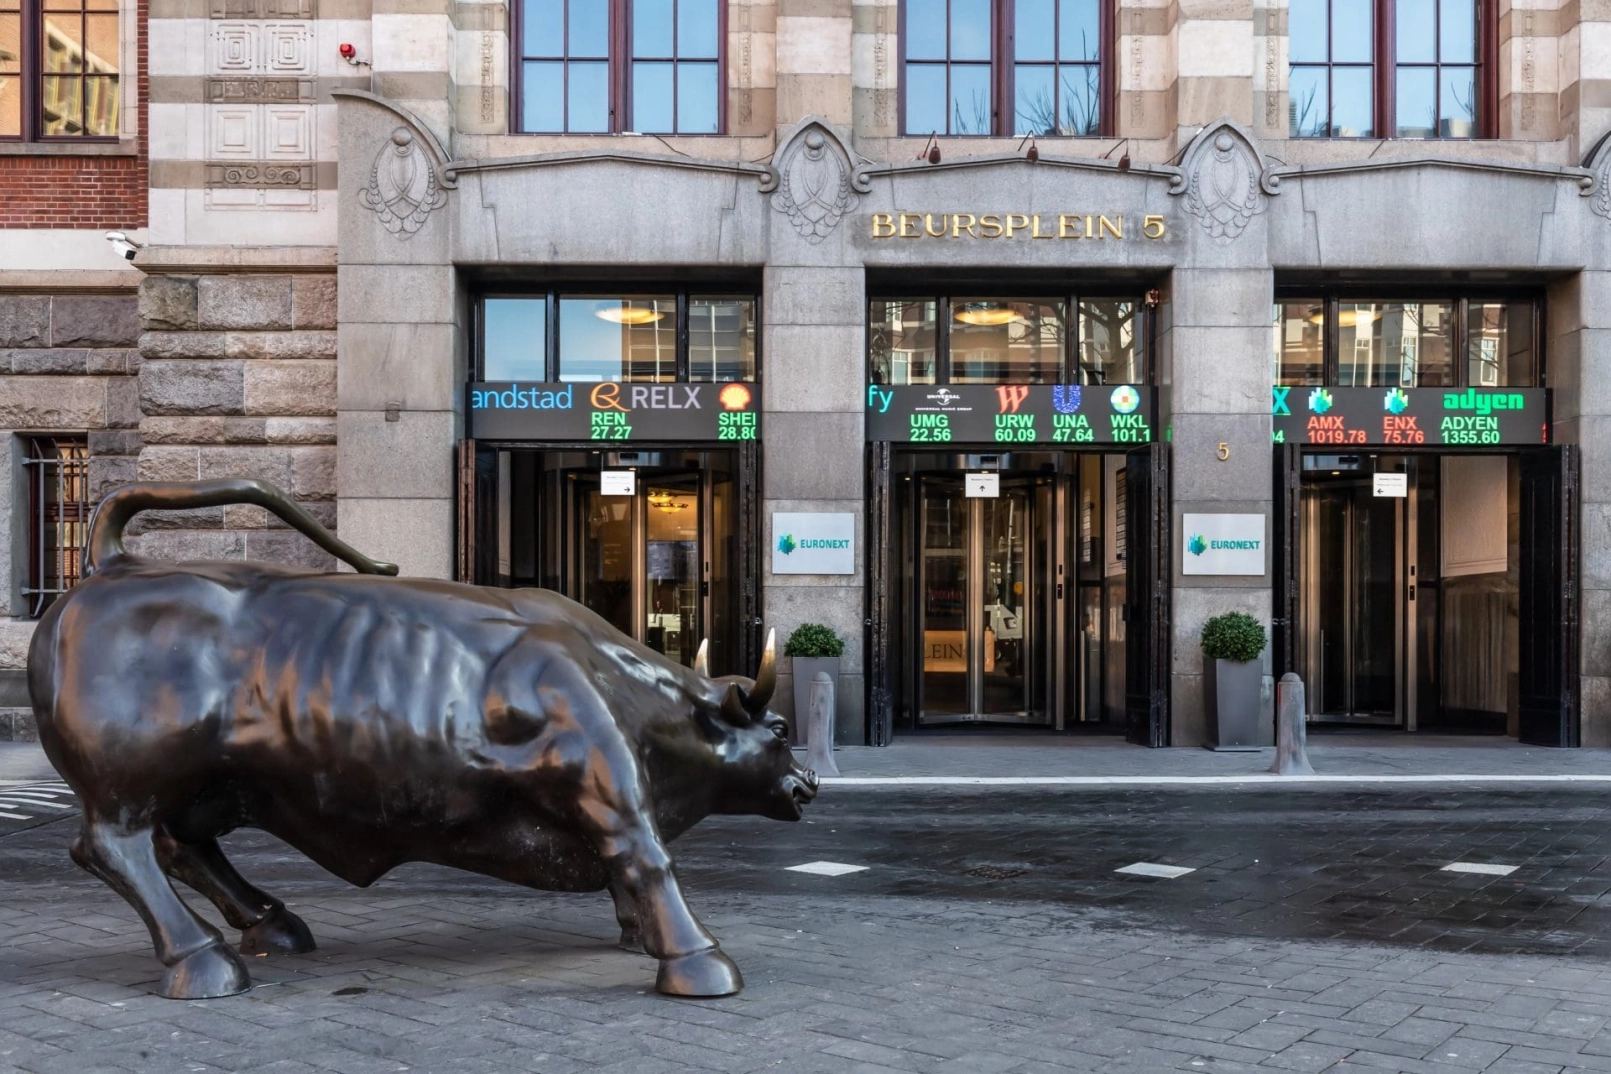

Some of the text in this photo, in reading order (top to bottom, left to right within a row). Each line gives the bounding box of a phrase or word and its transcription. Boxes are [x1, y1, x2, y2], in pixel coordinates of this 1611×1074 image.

[872, 214, 1166, 239] BEURSPLEIN 5
[472, 383, 573, 409] andstad
[631, 386, 702, 409] RELX
[868, 384, 894, 413] fy
[1443, 388, 1524, 415] adyen
[591, 411, 626, 426] REN
[910, 413, 949, 428] UMG
[995, 414, 1035, 428] URW
[1053, 414, 1089, 428] UNA
[1110, 414, 1149, 428] WKL
[1307, 415, 1345, 430] AMX
[1383, 416, 1418, 430] ENX
[1441, 416, 1498, 430] ADYEN
[591, 426, 632, 440] 27.27
[910, 428, 951, 442] 22.56
[995, 428, 1036, 442] 60.09
[1052, 428, 1095, 442] 47.64
[1111, 428, 1150, 442] 101.1
[1308, 430, 1367, 444] 1019.78
[1383, 430, 1424, 444] 75.76
[1441, 430, 1500, 444] 1355.60
[1217, 442, 1230, 461] 5
[800, 539, 850, 549] EURONEXT
[1210, 540, 1260, 550] EURONEXT
